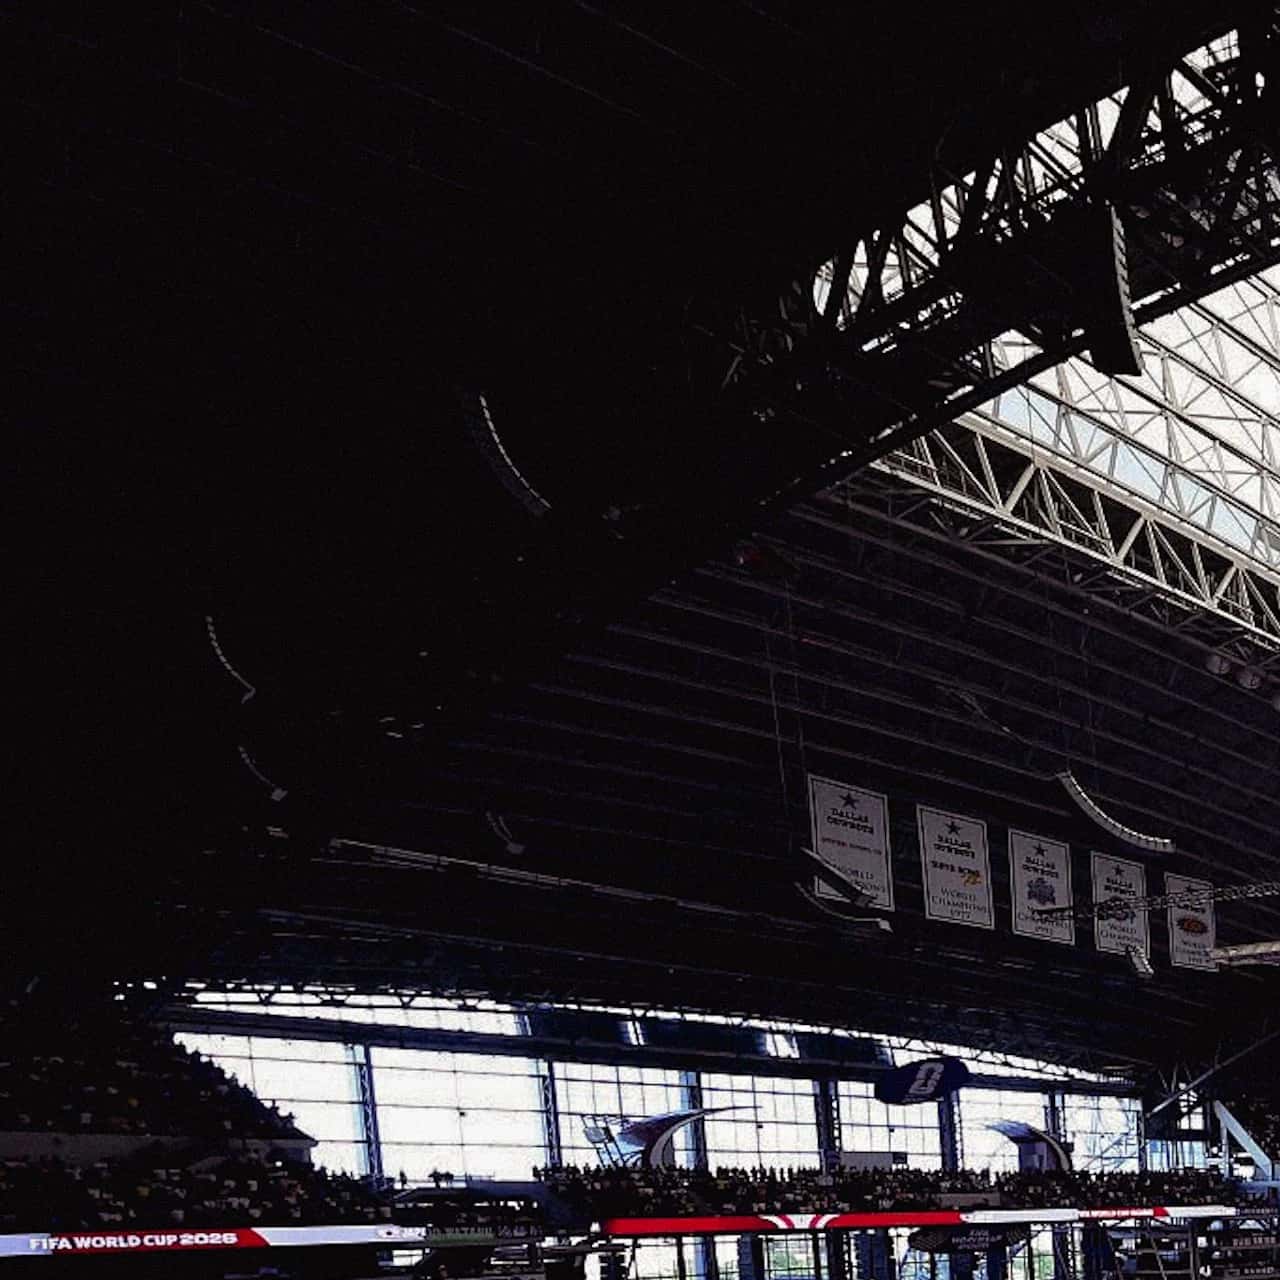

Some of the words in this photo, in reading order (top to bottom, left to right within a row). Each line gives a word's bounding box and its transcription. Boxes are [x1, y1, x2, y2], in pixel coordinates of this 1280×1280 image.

[29, 1236, 72, 1250] FIFA
[75, 1234, 141, 1249] WORLD
[145, 1234, 178, 1247] CUP
[179, 1232, 238, 1245] 2026
